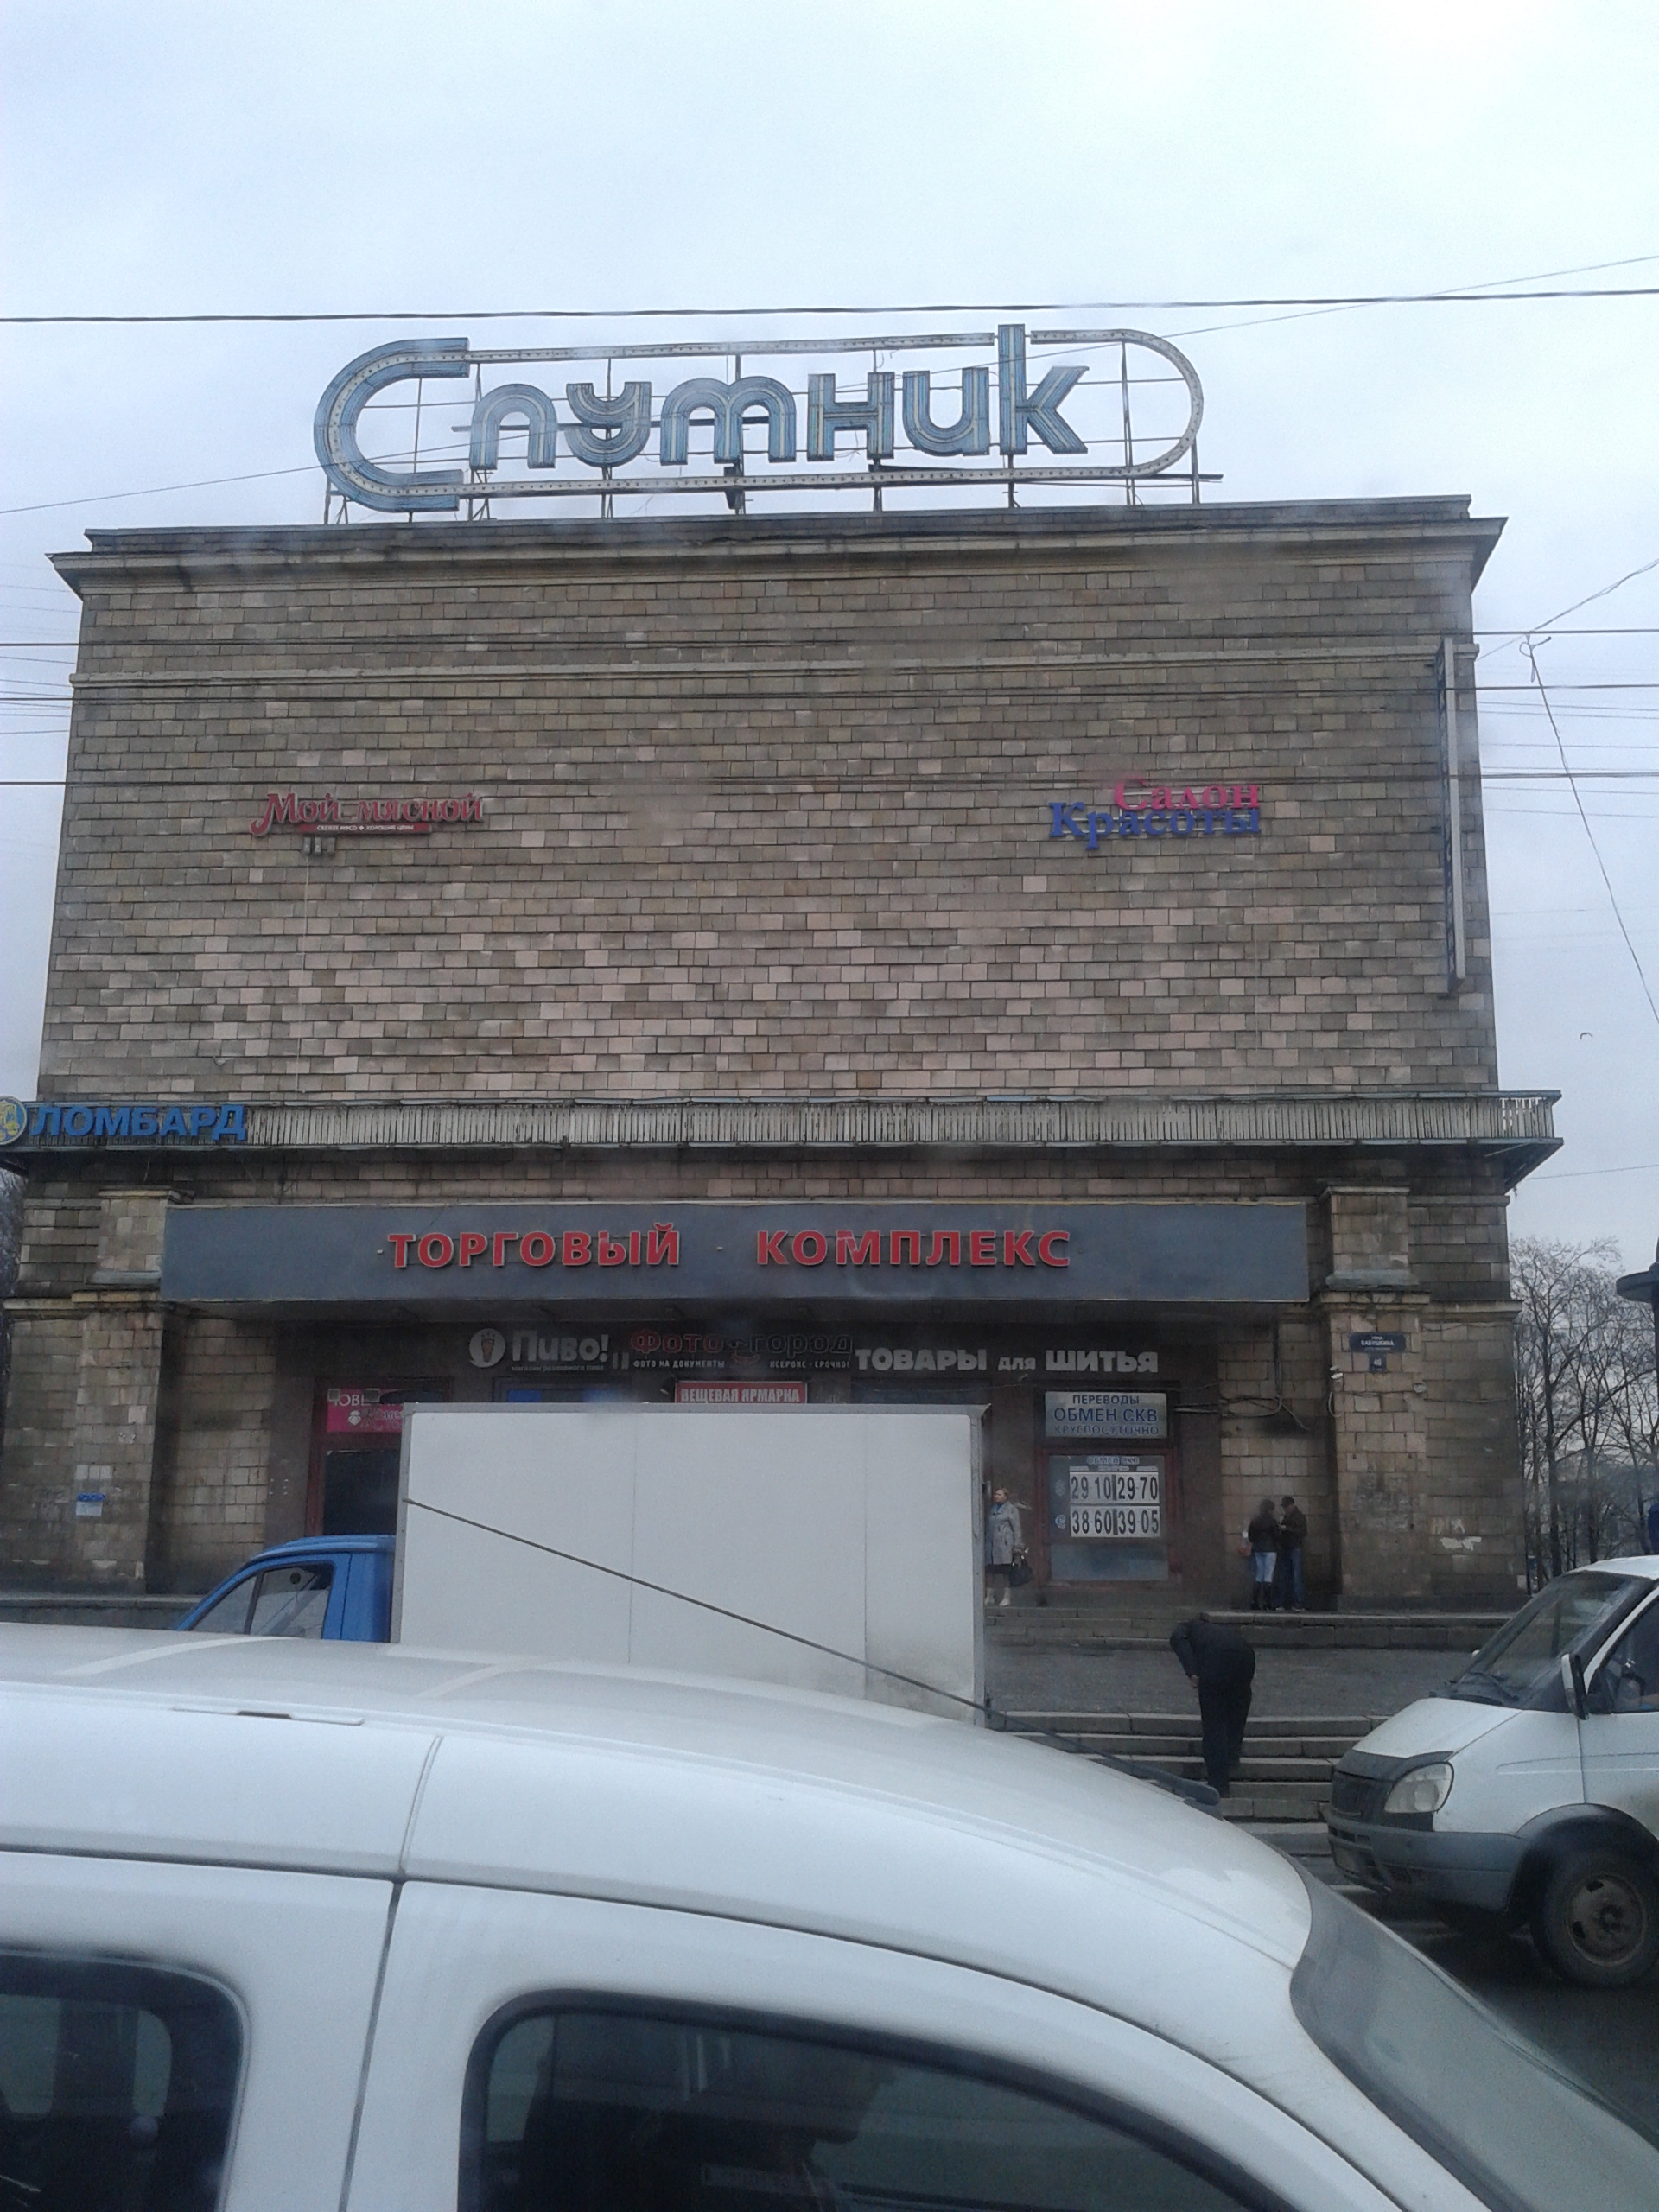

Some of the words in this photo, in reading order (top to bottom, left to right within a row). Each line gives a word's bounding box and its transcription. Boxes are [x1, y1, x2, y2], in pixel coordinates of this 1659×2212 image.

[314, 324, 1089, 512] Спутник
[1114, 777, 1259, 810] Салон
[251, 792, 340, 836] Мой
[355, 792, 483, 822] мясной
[1049, 801, 1261, 849] Красоты
[29, 1104, 247, 1141] ЛОМБАРД
[388, 1222, 680, 1268] ТОРГОВЫЙ
[757, 1230, 1071, 1268] КОМПЛЕКС
[512, 1330, 609, 1363] Пиво!
[631, 1329, 724, 1354] Фото
[750, 1333, 853, 1358] город
[672, 1359, 725, 1368] ДОКУМЕНТЫ
[855, 1349, 987, 1371] ТОВАРЫ
[998, 1357, 1036, 1370] для
[1046, 1350, 1159, 1373] ШИТЬЯ
[680, 1389, 738, 1402] ВЕЩЕВАЯ
[741, 1389, 800, 1402] ЯРМАРКА
[1072, 1395, 1140, 1405] ПЕРЕВОДЫ
[1053, 1408, 1117, 1421] ОБМЕН
[1122, 1408, 1158, 1422] СКВ
[1054, 1425, 1160, 1436] КРУГЛОСУТОЧНО
